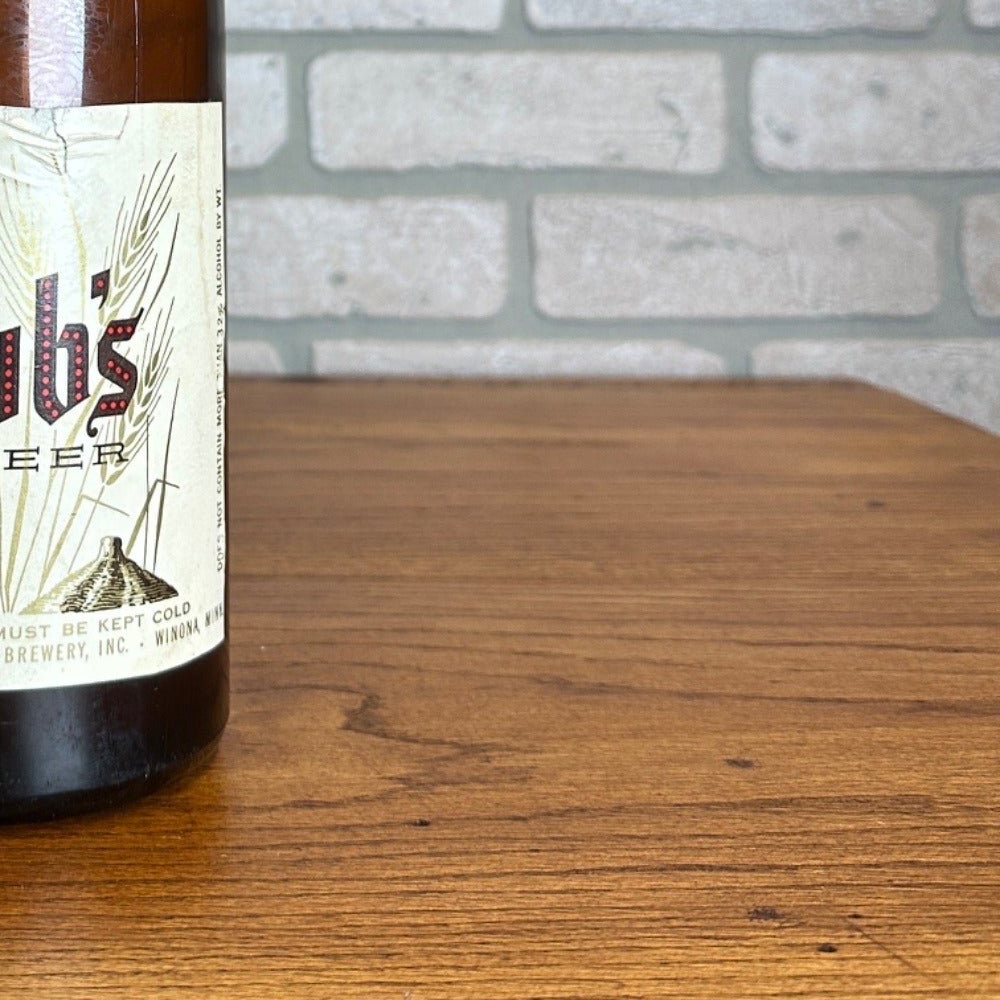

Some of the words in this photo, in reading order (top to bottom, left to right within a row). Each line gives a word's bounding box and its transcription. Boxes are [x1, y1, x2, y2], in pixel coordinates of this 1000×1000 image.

[216, 212, 222, 229] BY
[63, 620, 89, 638] BE
[98, 614, 145, 633] KEPT
[152, 601, 191, 624] COLD
[4, 641, 89, 663] BREWERY,
[98, 636, 129, 657] INC.
